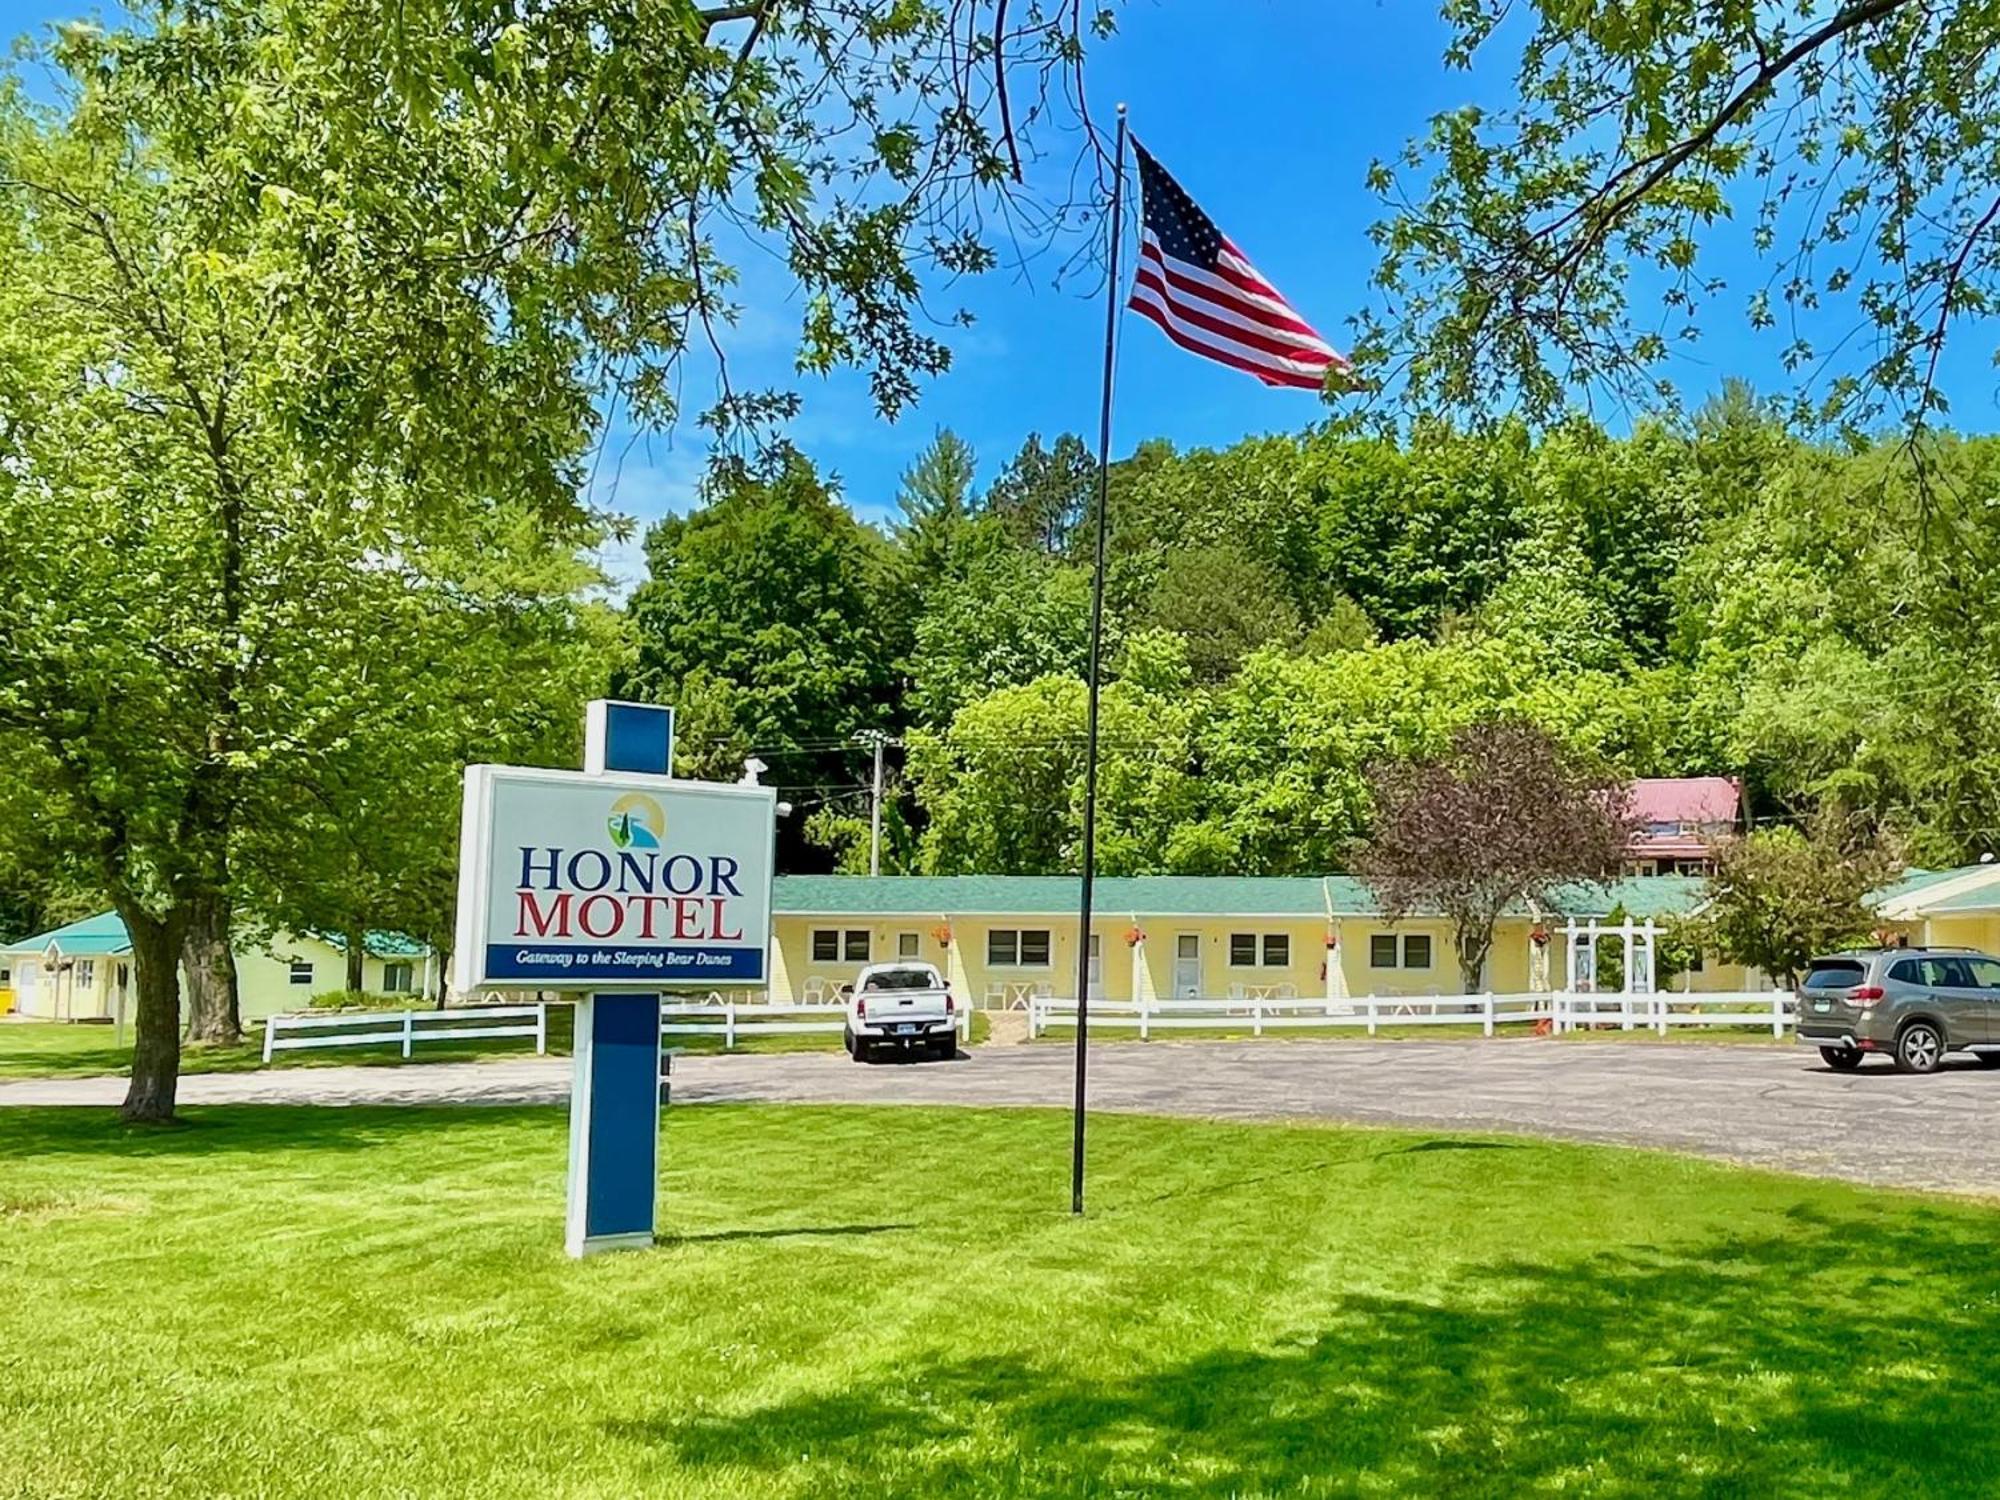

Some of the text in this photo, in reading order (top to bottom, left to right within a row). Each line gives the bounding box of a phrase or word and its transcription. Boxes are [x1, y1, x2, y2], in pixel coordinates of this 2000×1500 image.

[516, 846, 744, 897] HONOR
[513, 891, 743, 941] MOTEL
[516, 949, 732, 968] Gateway to the Sleeping Bear Dunes
